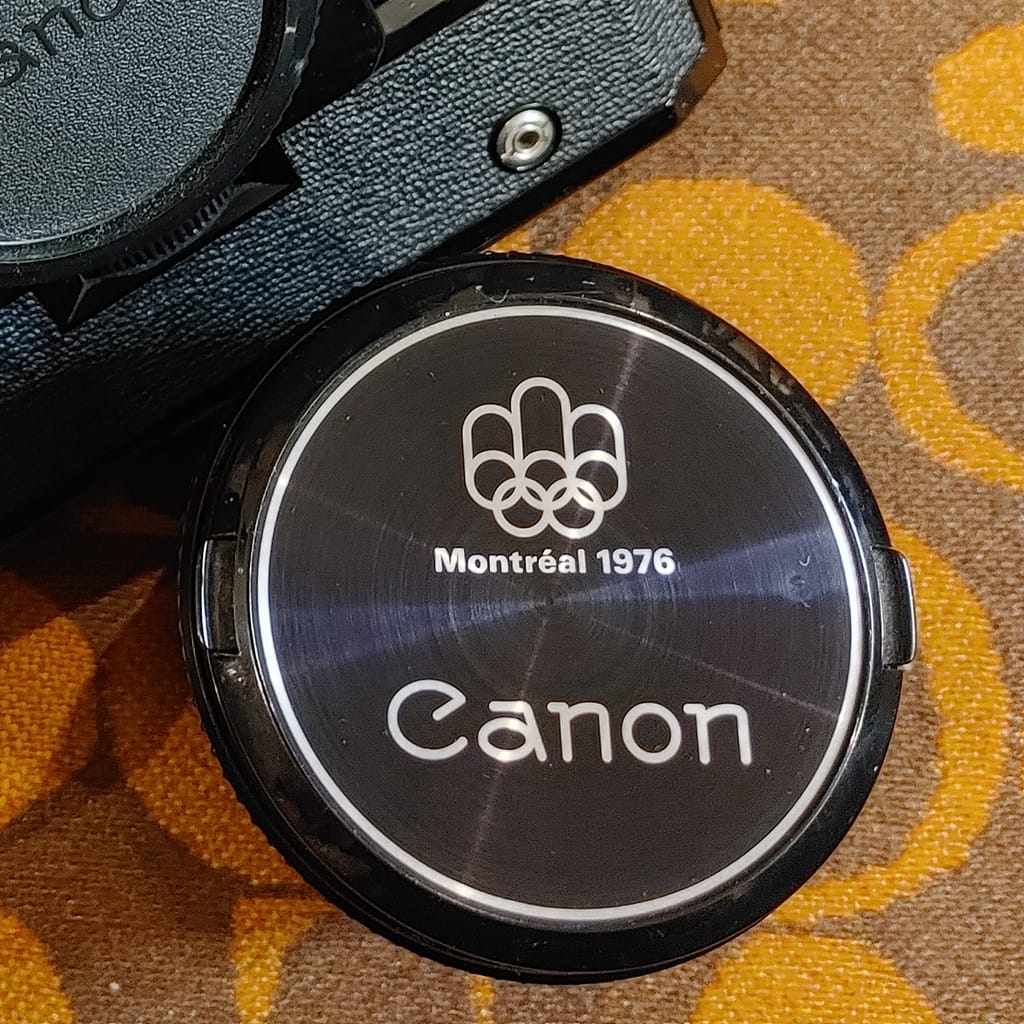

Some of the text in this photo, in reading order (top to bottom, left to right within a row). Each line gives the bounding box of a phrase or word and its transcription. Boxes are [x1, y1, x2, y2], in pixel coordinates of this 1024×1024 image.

[433, 547, 676, 576] Montréal 1976
[386, 679, 753, 766] Canon
